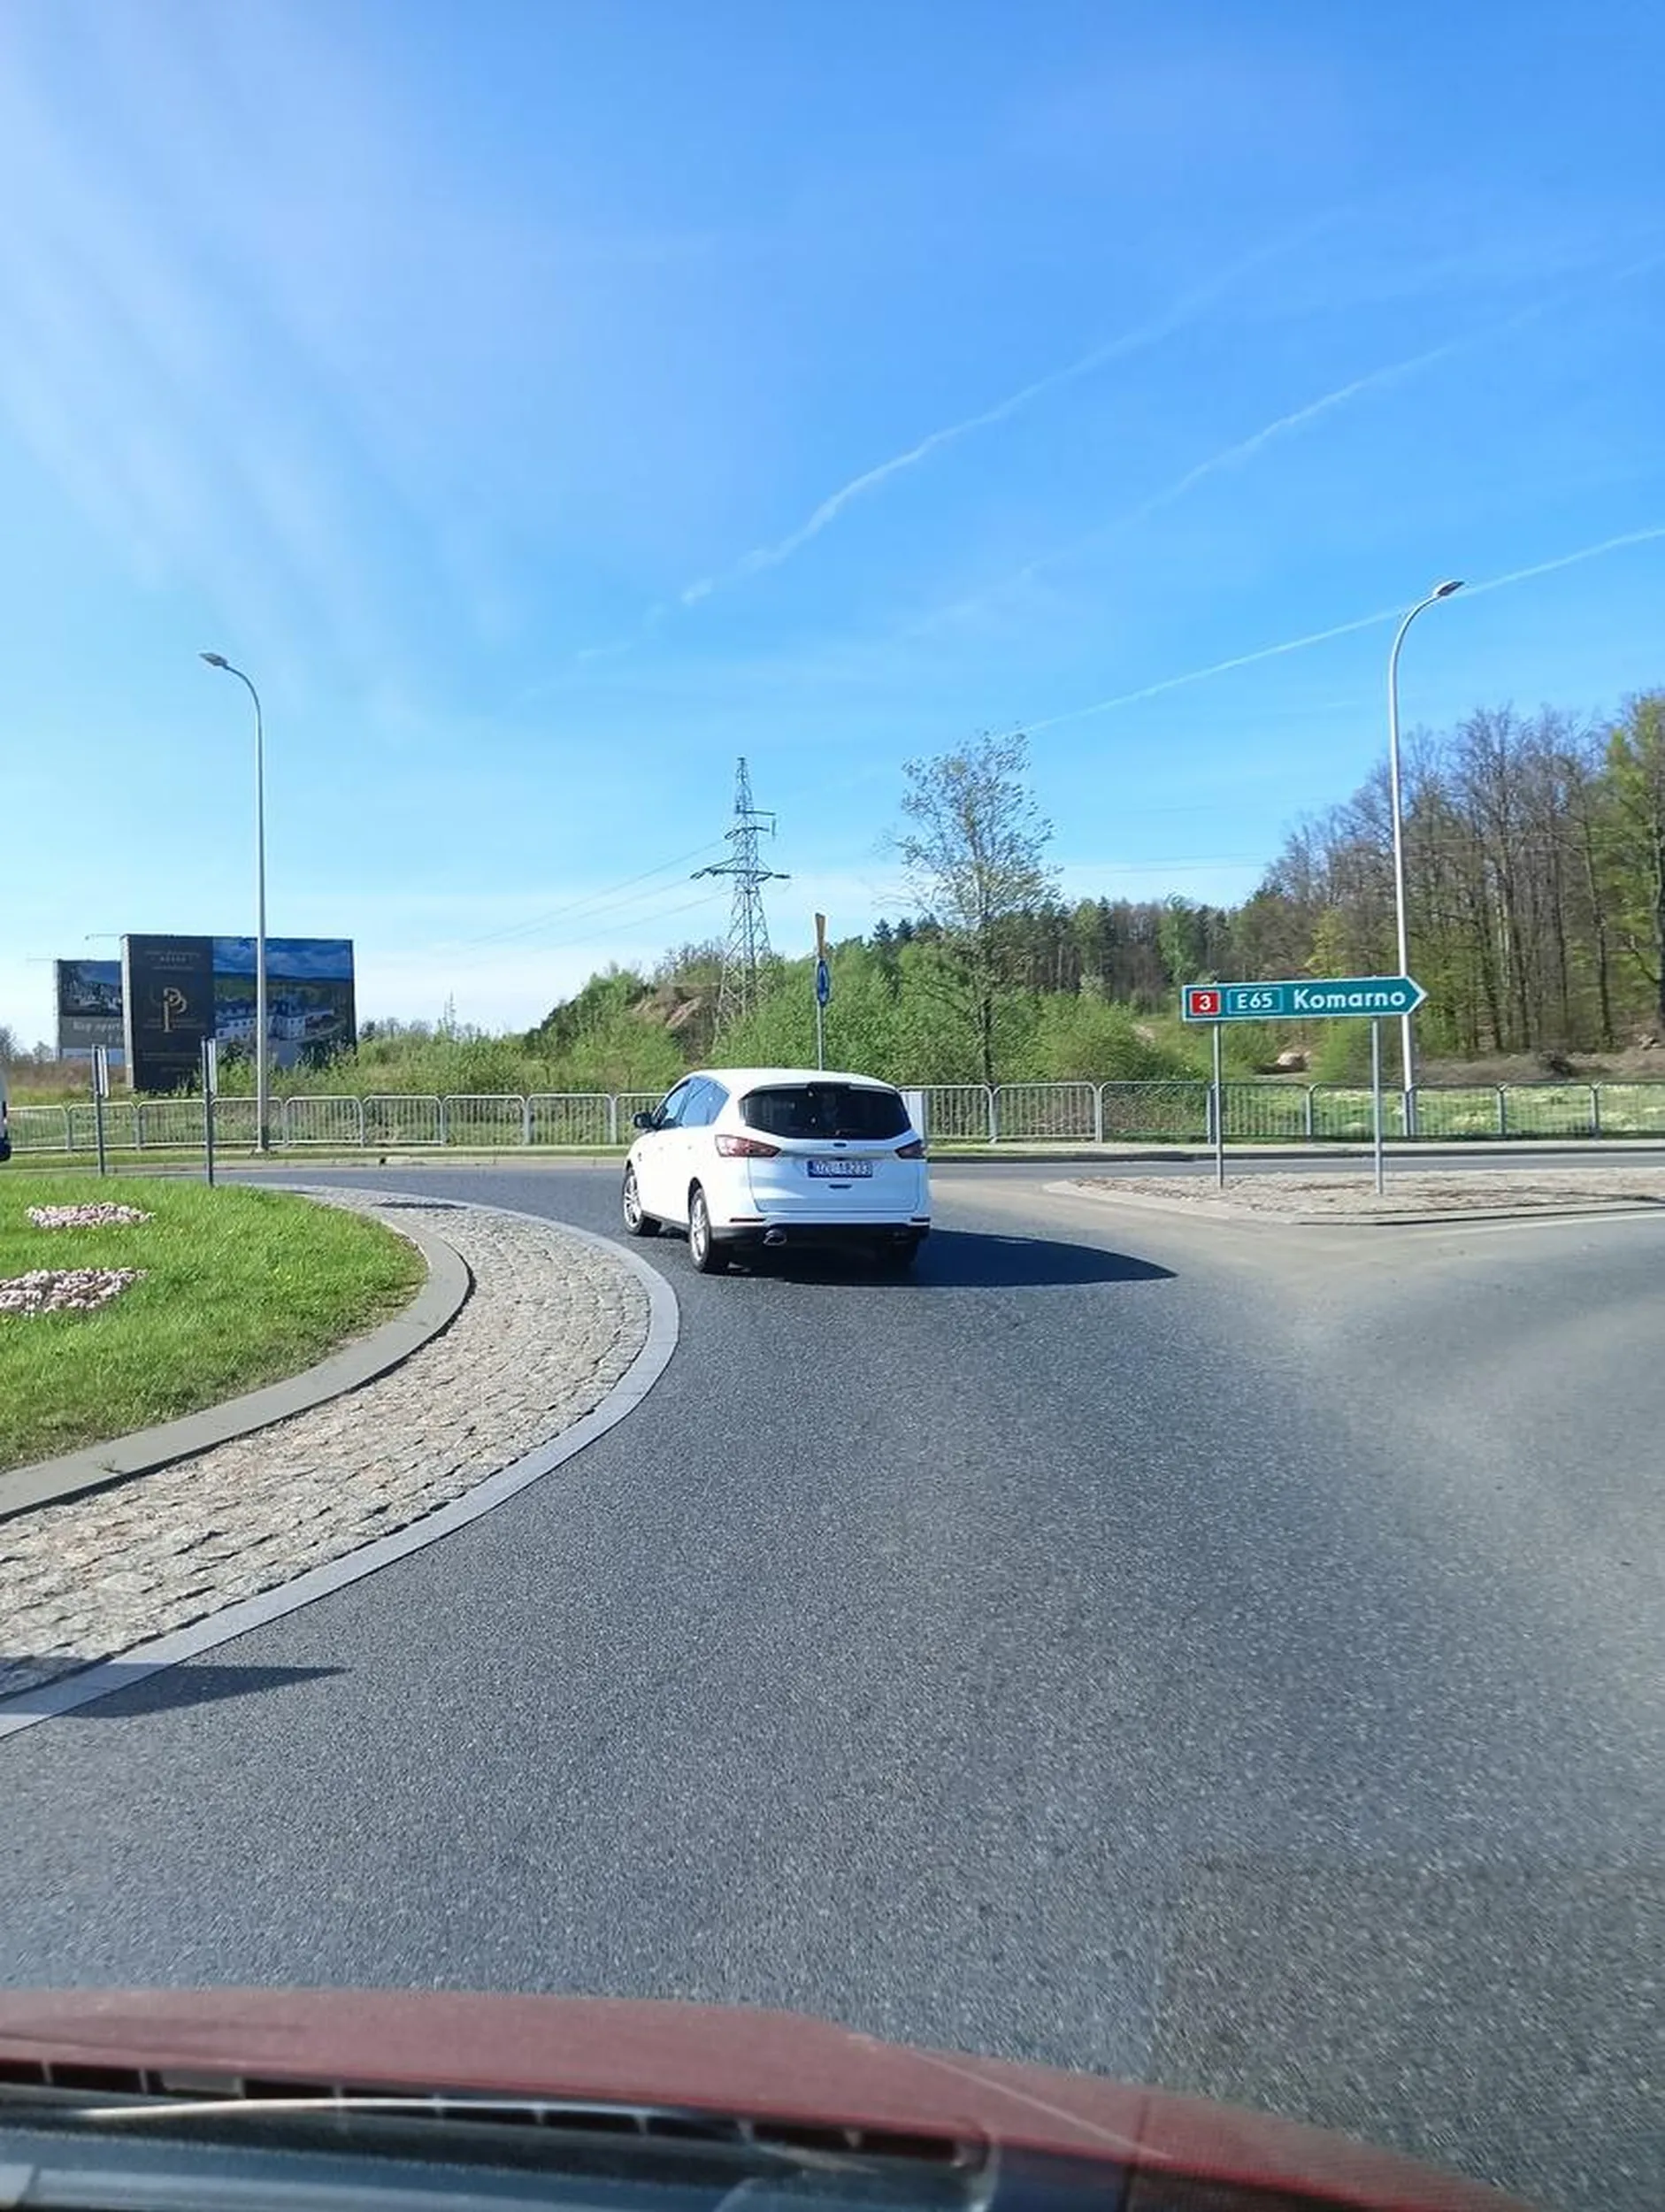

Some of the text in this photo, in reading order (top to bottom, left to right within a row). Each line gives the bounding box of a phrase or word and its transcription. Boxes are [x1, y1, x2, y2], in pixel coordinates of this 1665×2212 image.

[1198, 988, 1406, 1010] 3 E65 Komarno
